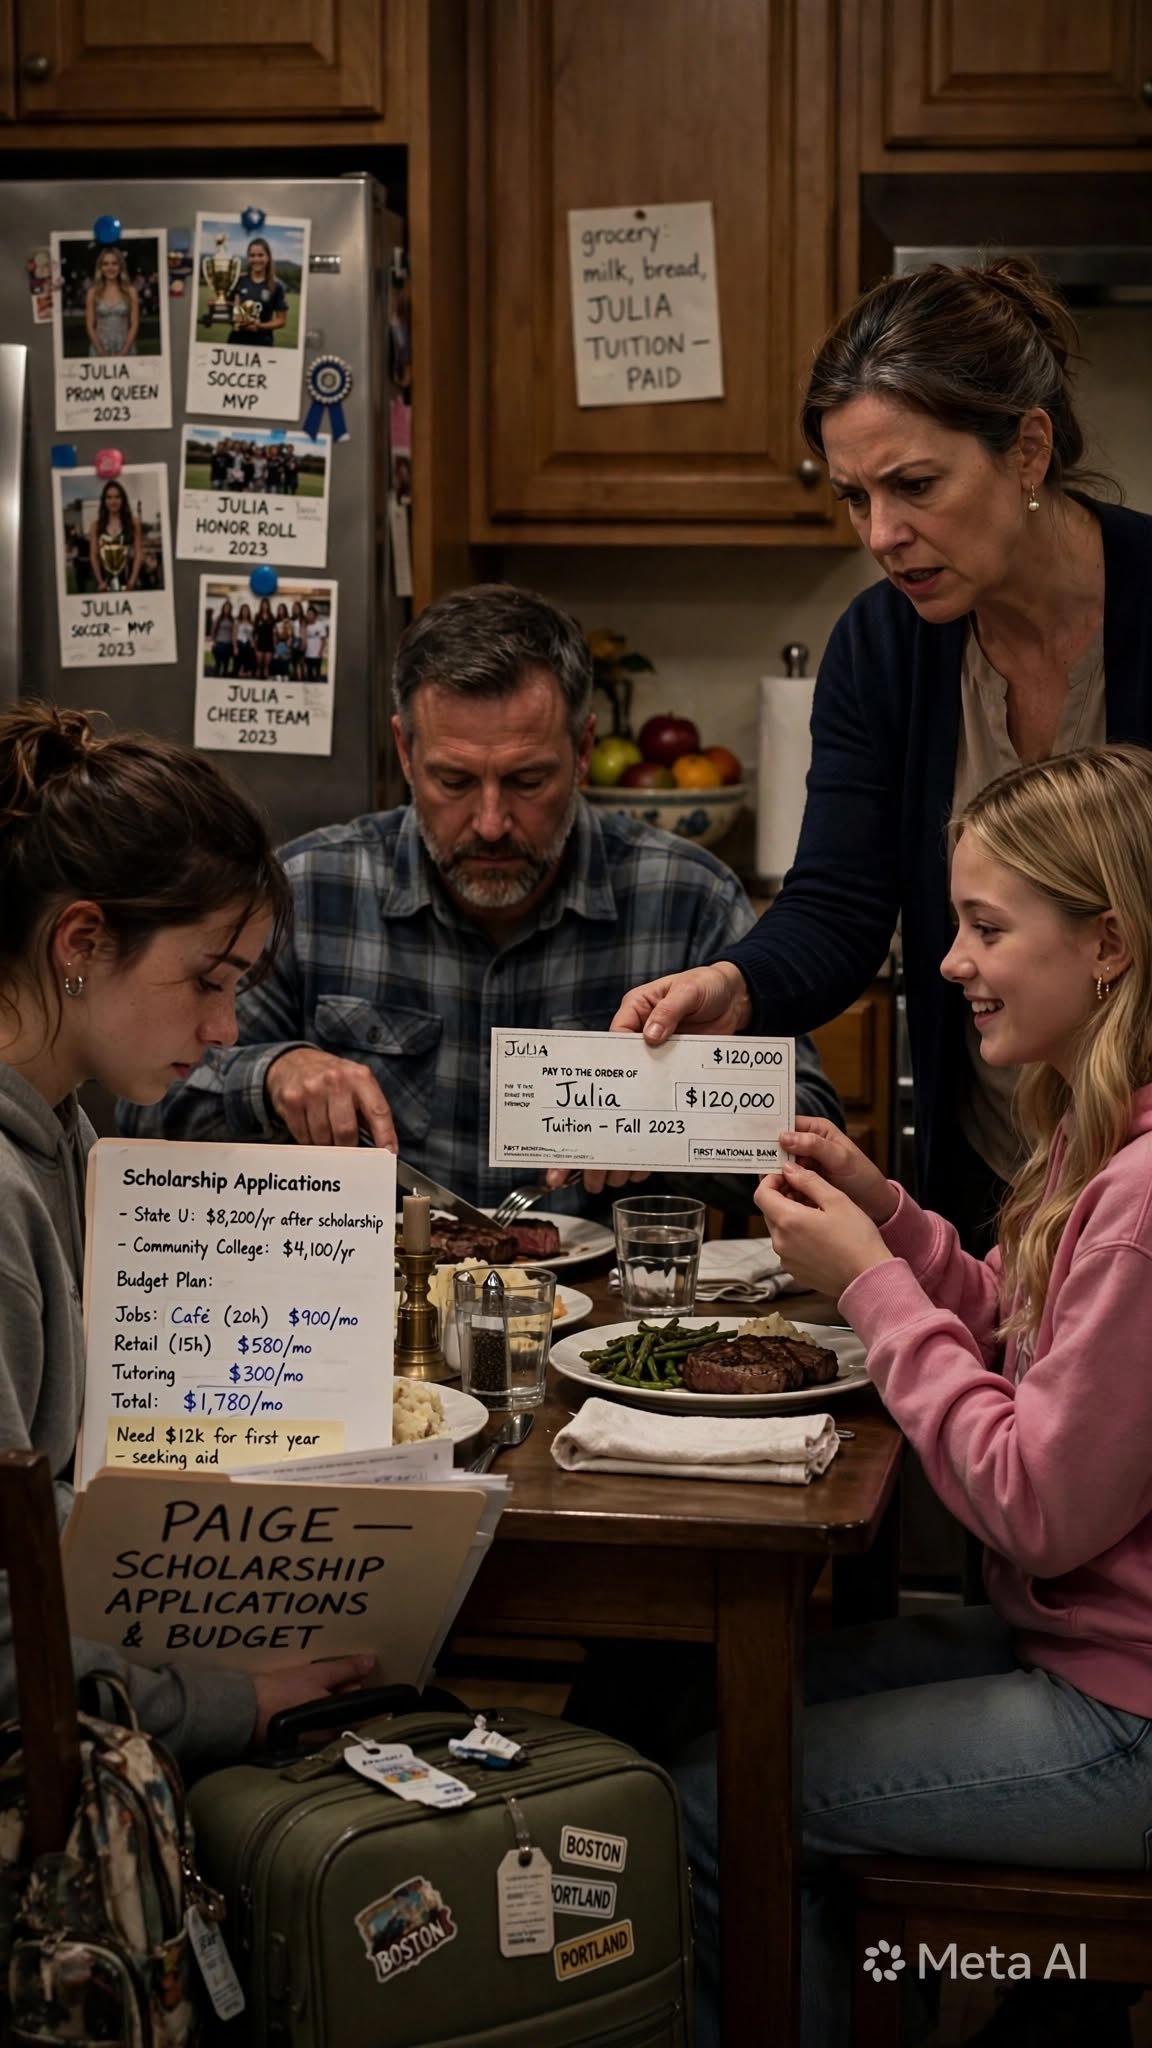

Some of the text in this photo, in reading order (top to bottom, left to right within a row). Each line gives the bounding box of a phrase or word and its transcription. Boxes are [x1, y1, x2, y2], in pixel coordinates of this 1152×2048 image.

[582, 225, 670, 257] grocery:
[584, 253, 705, 284] milk, bread,
[588, 293, 672, 324] JULIA
[585, 334, 684, 359] TUITION
[212, 349, 261, 367] JULIA
[80, 364, 129, 380] JULIA
[208, 371, 266, 389] SOCCER
[627, 367, 681, 389] PAID
[66, 385, 158, 401] PROM QUEEN
[223, 395, 259, 410] MVP
[94, 407, 130, 421] 2023
[218, 497, 268, 514] JULIA
[196, 519, 296, 538] HONOR ROLL
[229, 541, 267, 556] 2023
[82, 600, 132, 617] JULIA
[128, 620, 155, 637] MVP
[99, 642, 135, 657] 2023
[228, 686, 278, 703] JULIA
[208, 707, 309, 725] CHEER TEAM
[239, 730, 277, 745] 2023
[714, 1048, 782, 1067] $120,000
[543, 1067, 558, 1075] PAY
[561, 1068, 572, 1076] TO
[576, 1068, 592, 1076] THE
[595, 1069, 623, 1077] ORDER
[556, 1081, 774, 1112] Julia $120,000
[542, 1117, 591, 1132] Tuition
[616, 1118, 640, 1133] Fall
[649, 1120, 685, 1134] 2023
[757, 1149, 777, 1157] BANK
[123, 1169, 340, 1195] Scholarship Applications
[135, 1206, 170, 1222] State
[179, 1209, 194, 1222] U:
[207, 1208, 275, 1231] $8,200/yr
[281, 1211, 313, 1226] after
[319, 1213, 383, 1234] scholarship
[134, 1237, 208, 1260] Community
[217, 1239, 268, 1261] College:
[283, 1240, 355, 1264] $4,100/yr
[118, 1271, 212, 1293] Budget Plan:
[116, 1305, 358, 1330] Jobs: Café (20h) $900/mo
[115, 1333, 311, 1358] Retail (15h) $580/mo
[112, 1363, 303, 1387] Tutoring $300/mo
[112, 1390, 282, 1416] Total: $1,780/mo
[118, 1426, 319, 1451] Need $12k for first year
[133, 1449, 186, 1469] seeking
[196, 1449, 218, 1464] aid
[162, 1501, 338, 1542] PAIGE
[112, 1551, 384, 1582] SCHOLARSHIP
[105, 1588, 368, 1615] APPLICATIONS
[122, 1622, 323, 1649] & BUDGET
[567, 1836, 621, 1862] BOSTON
[552, 1884, 611, 1909] ORTLAND
[376, 1919, 446, 1974] BOSTON
[561, 1931, 627, 1970] PORTLAND
